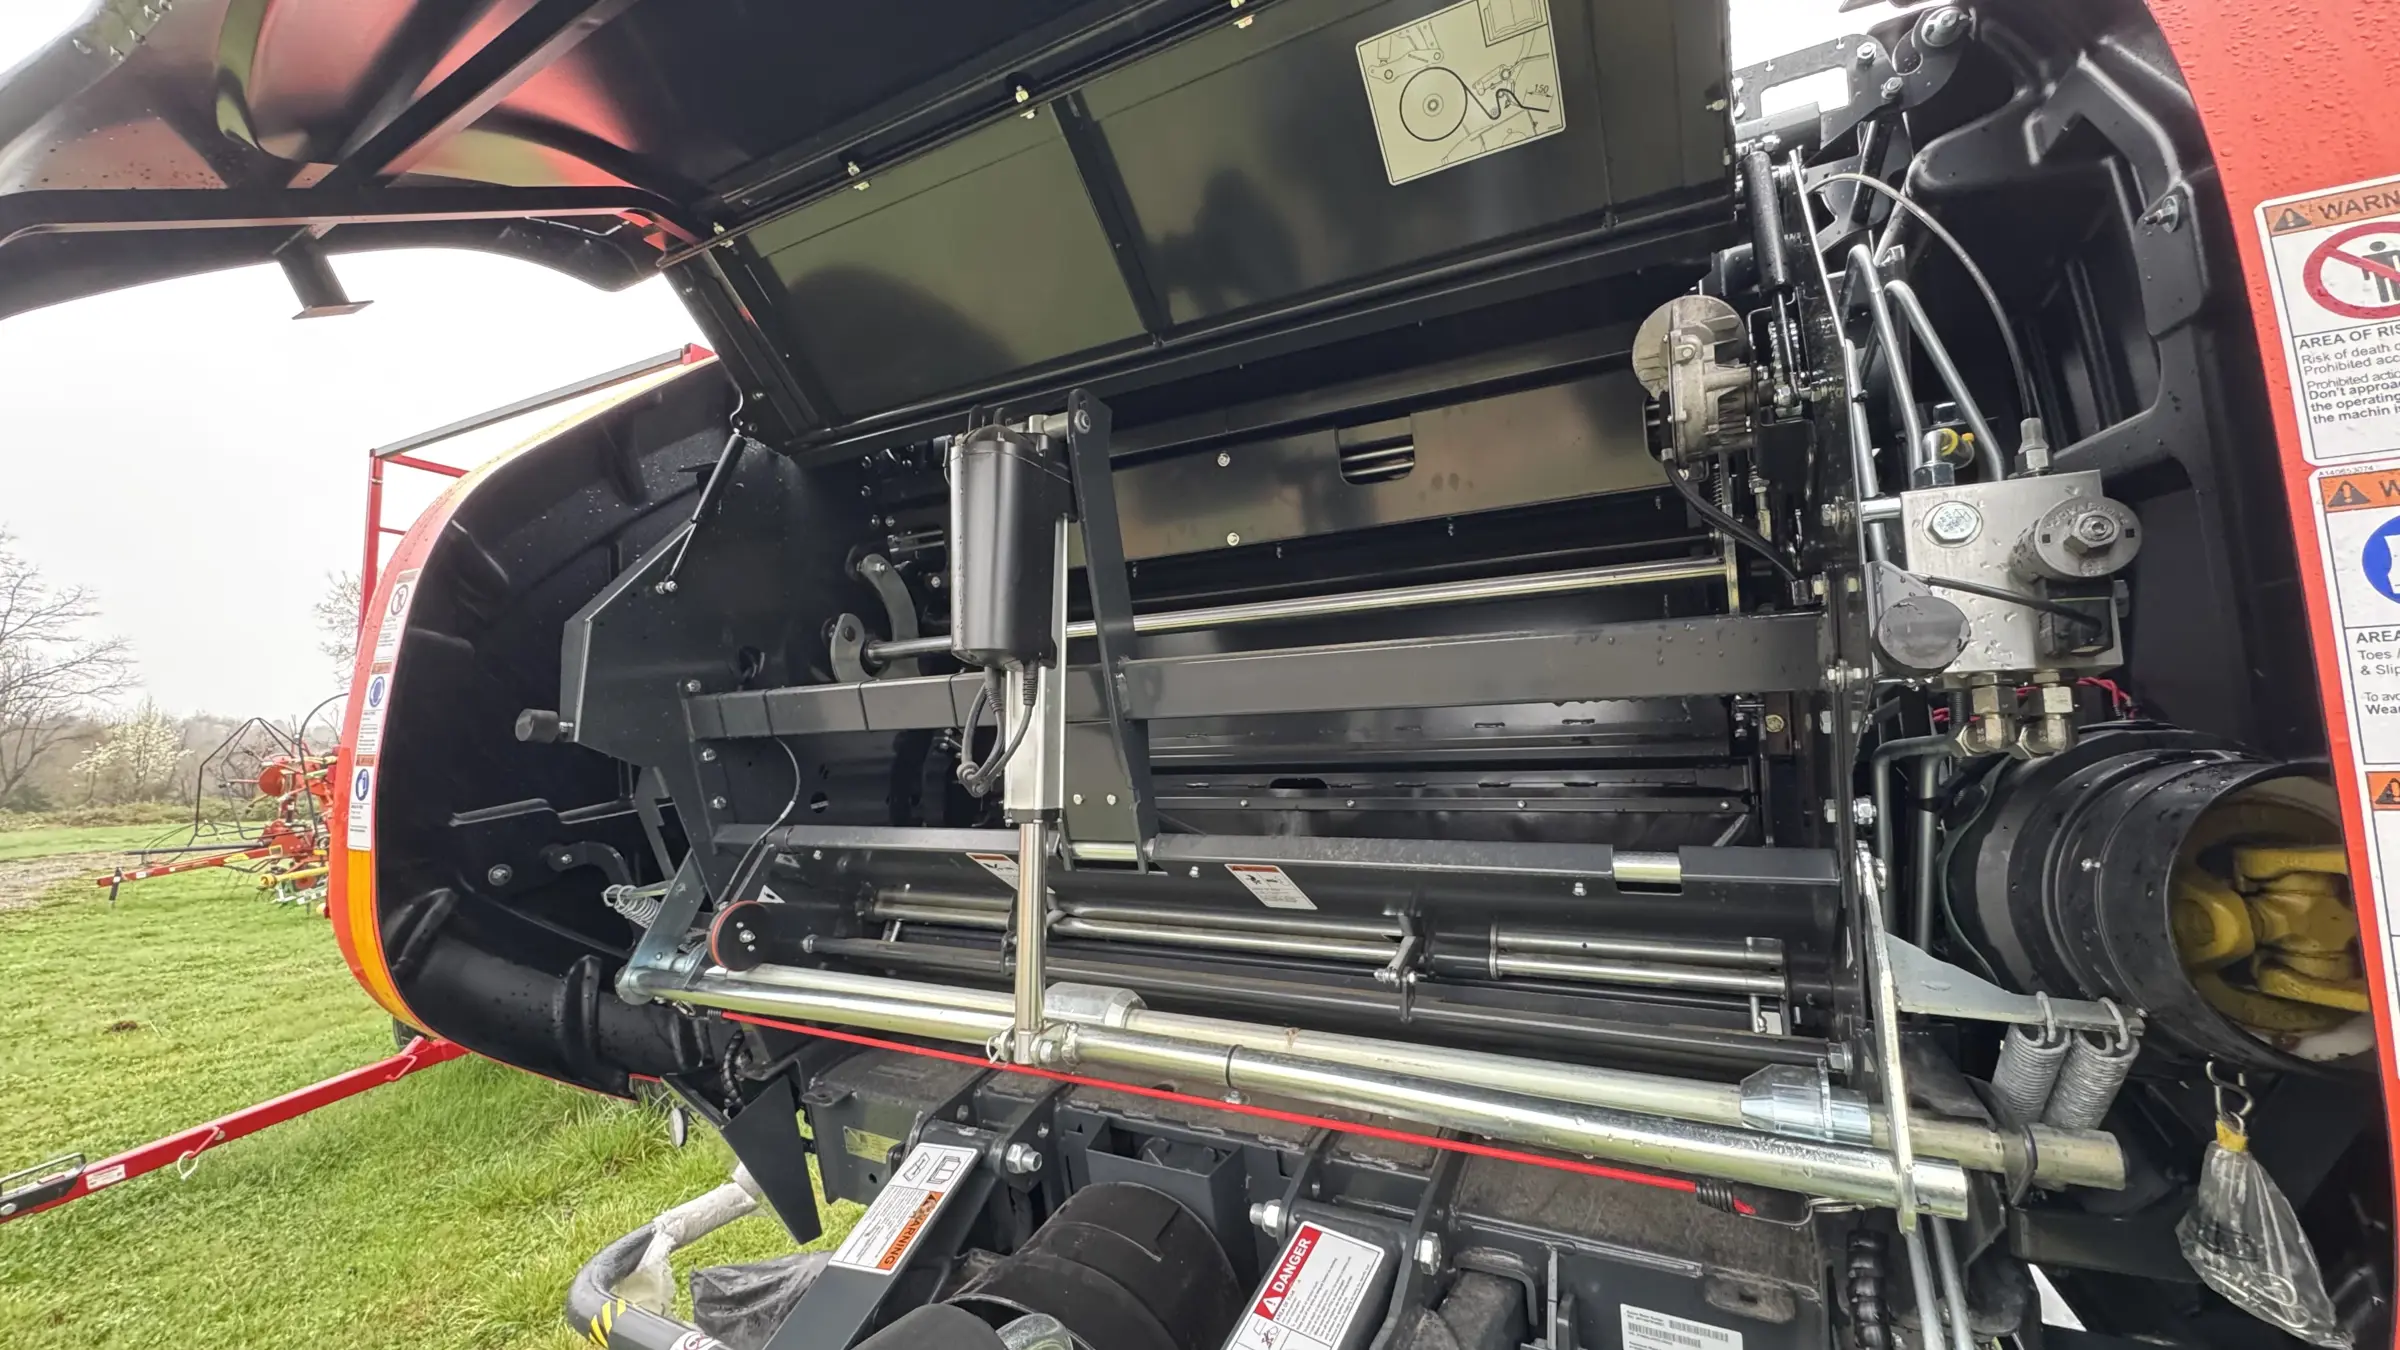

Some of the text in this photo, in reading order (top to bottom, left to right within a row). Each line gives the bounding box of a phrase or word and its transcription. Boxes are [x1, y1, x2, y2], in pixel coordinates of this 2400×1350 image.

[2317, 190, 2400, 221] WARN
[2299, 333, 2346, 350] AREA
[2349, 328, 2373, 341] OF
[2301, 352, 2331, 365] Risk
[2334, 348, 2348, 360] of
[2351, 343, 2391, 358] death
[2303, 357, 2372, 376] Prohibited
[2306, 373, 2369, 391] Prohibited
[2308, 381, 2400, 400] Don't approa
[2311, 392, 2400, 412] the operating
[2313, 414, 2335, 424] the
[2338, 406, 2390, 421] machin
[2357, 649, 2392, 660] Toes
[2360, 664, 2400, 677] & Slip
[2363, 691, 2379, 702] To
[2365, 703, 2400, 715] Wea
[1272, 1238, 1312, 1293] DANGER
